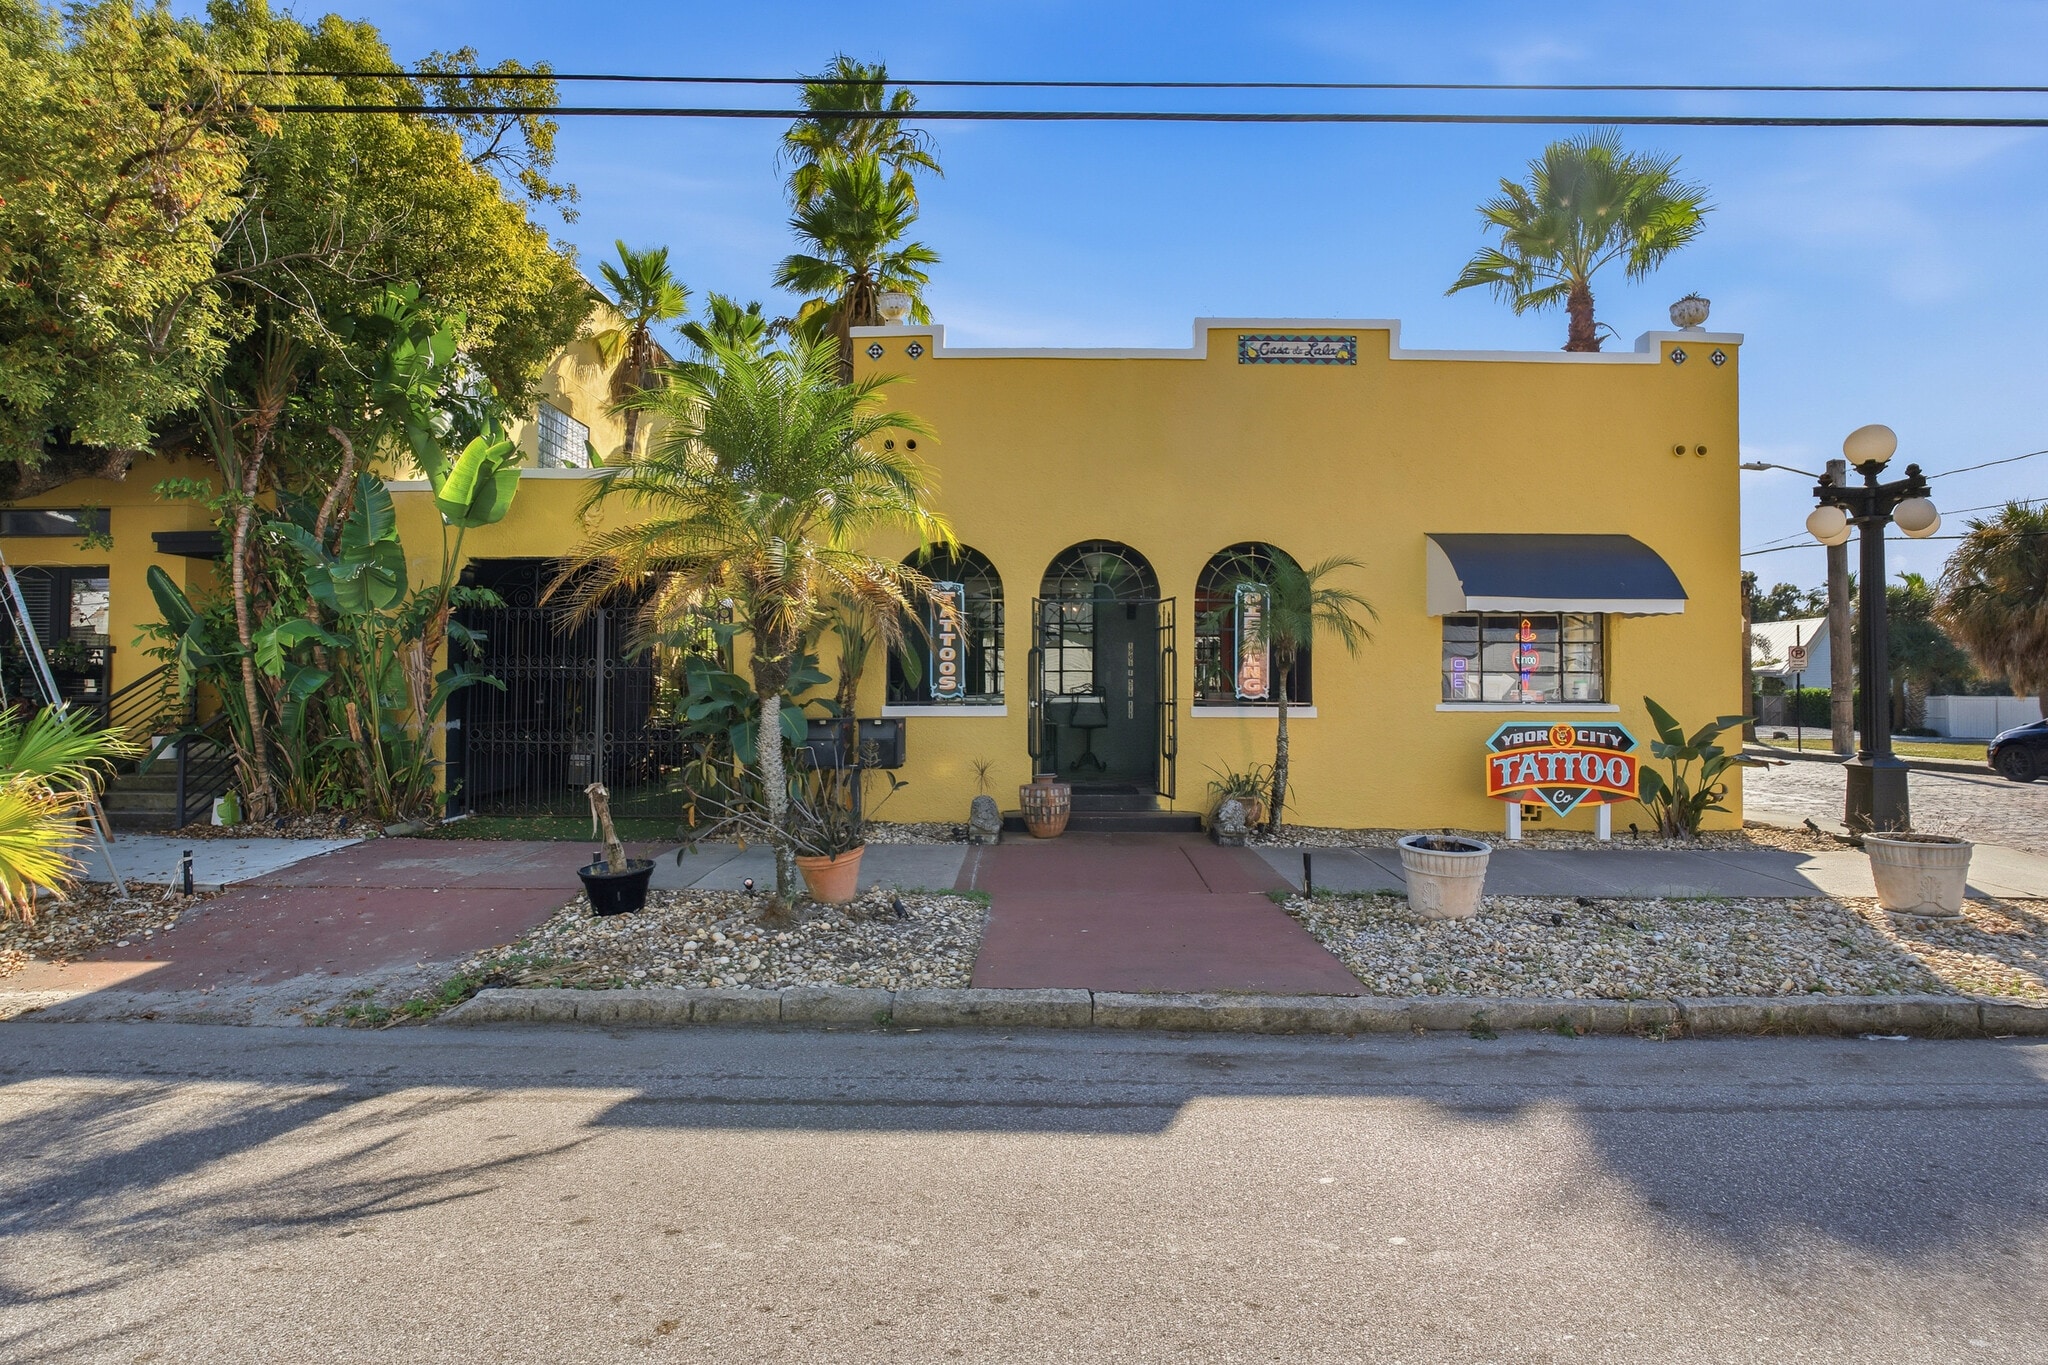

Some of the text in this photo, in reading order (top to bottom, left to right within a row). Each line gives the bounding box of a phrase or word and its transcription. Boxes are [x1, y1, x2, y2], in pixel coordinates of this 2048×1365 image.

[1259, 342, 1290, 355] Casa
[1304, 343, 1338, 357] Lala
[1243, 592, 1262, 690] PIEING
[1501, 730, 1623, 747] YBOR CITY
[1493, 751, 1631, 787] TATTOO
[1553, 789, 1574, 804] Co
